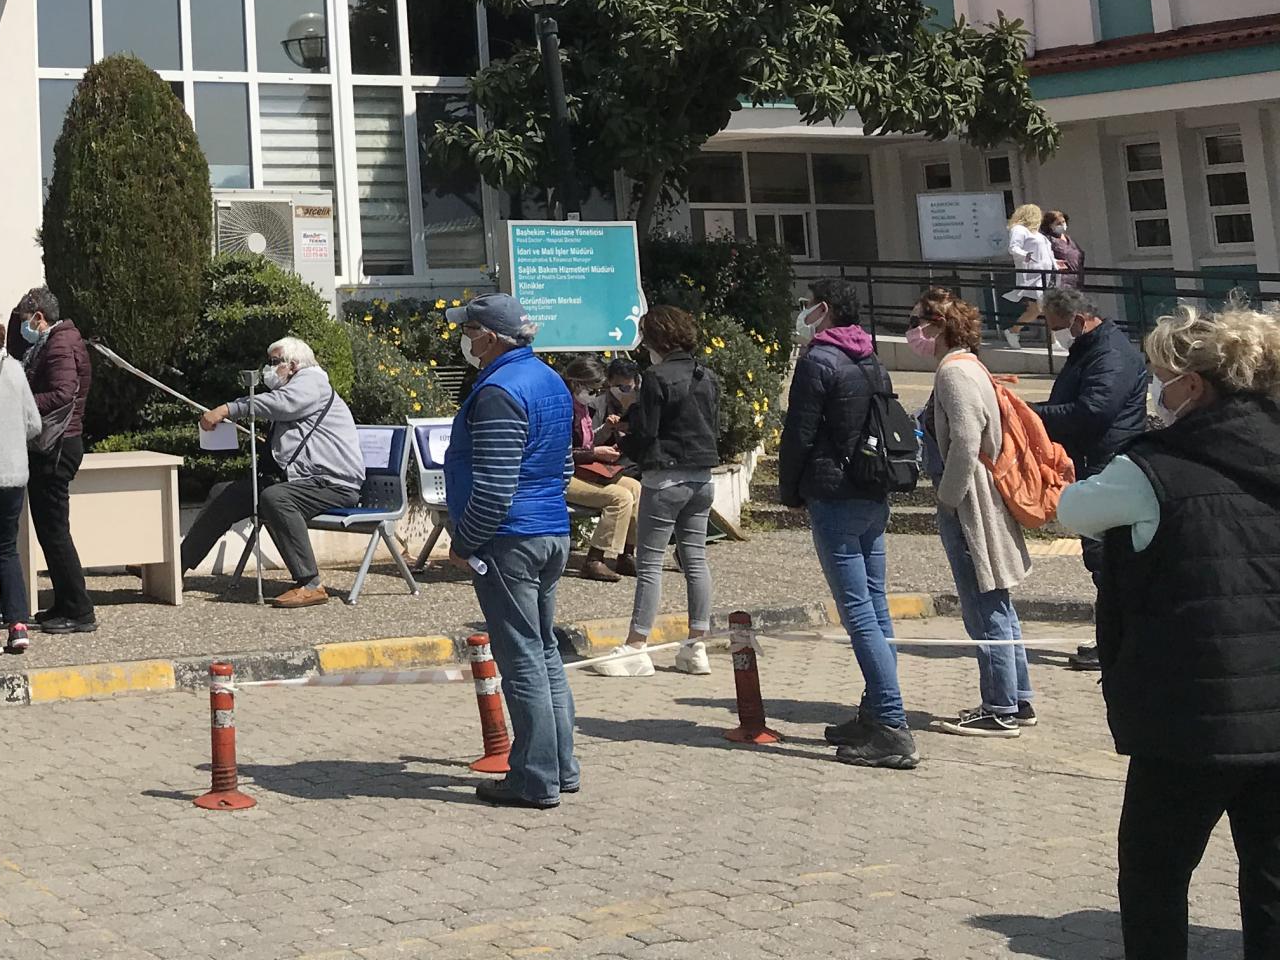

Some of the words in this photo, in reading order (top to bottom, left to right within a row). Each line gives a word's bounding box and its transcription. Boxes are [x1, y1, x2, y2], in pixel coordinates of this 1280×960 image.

[516, 228, 545, 236] Başhekim
[570, 247, 594, 255] Müdürü
[518, 266, 537, 274] Sağlık
[591, 265, 615, 273] Müdürü
[558, 296, 582, 304] Merkezi
